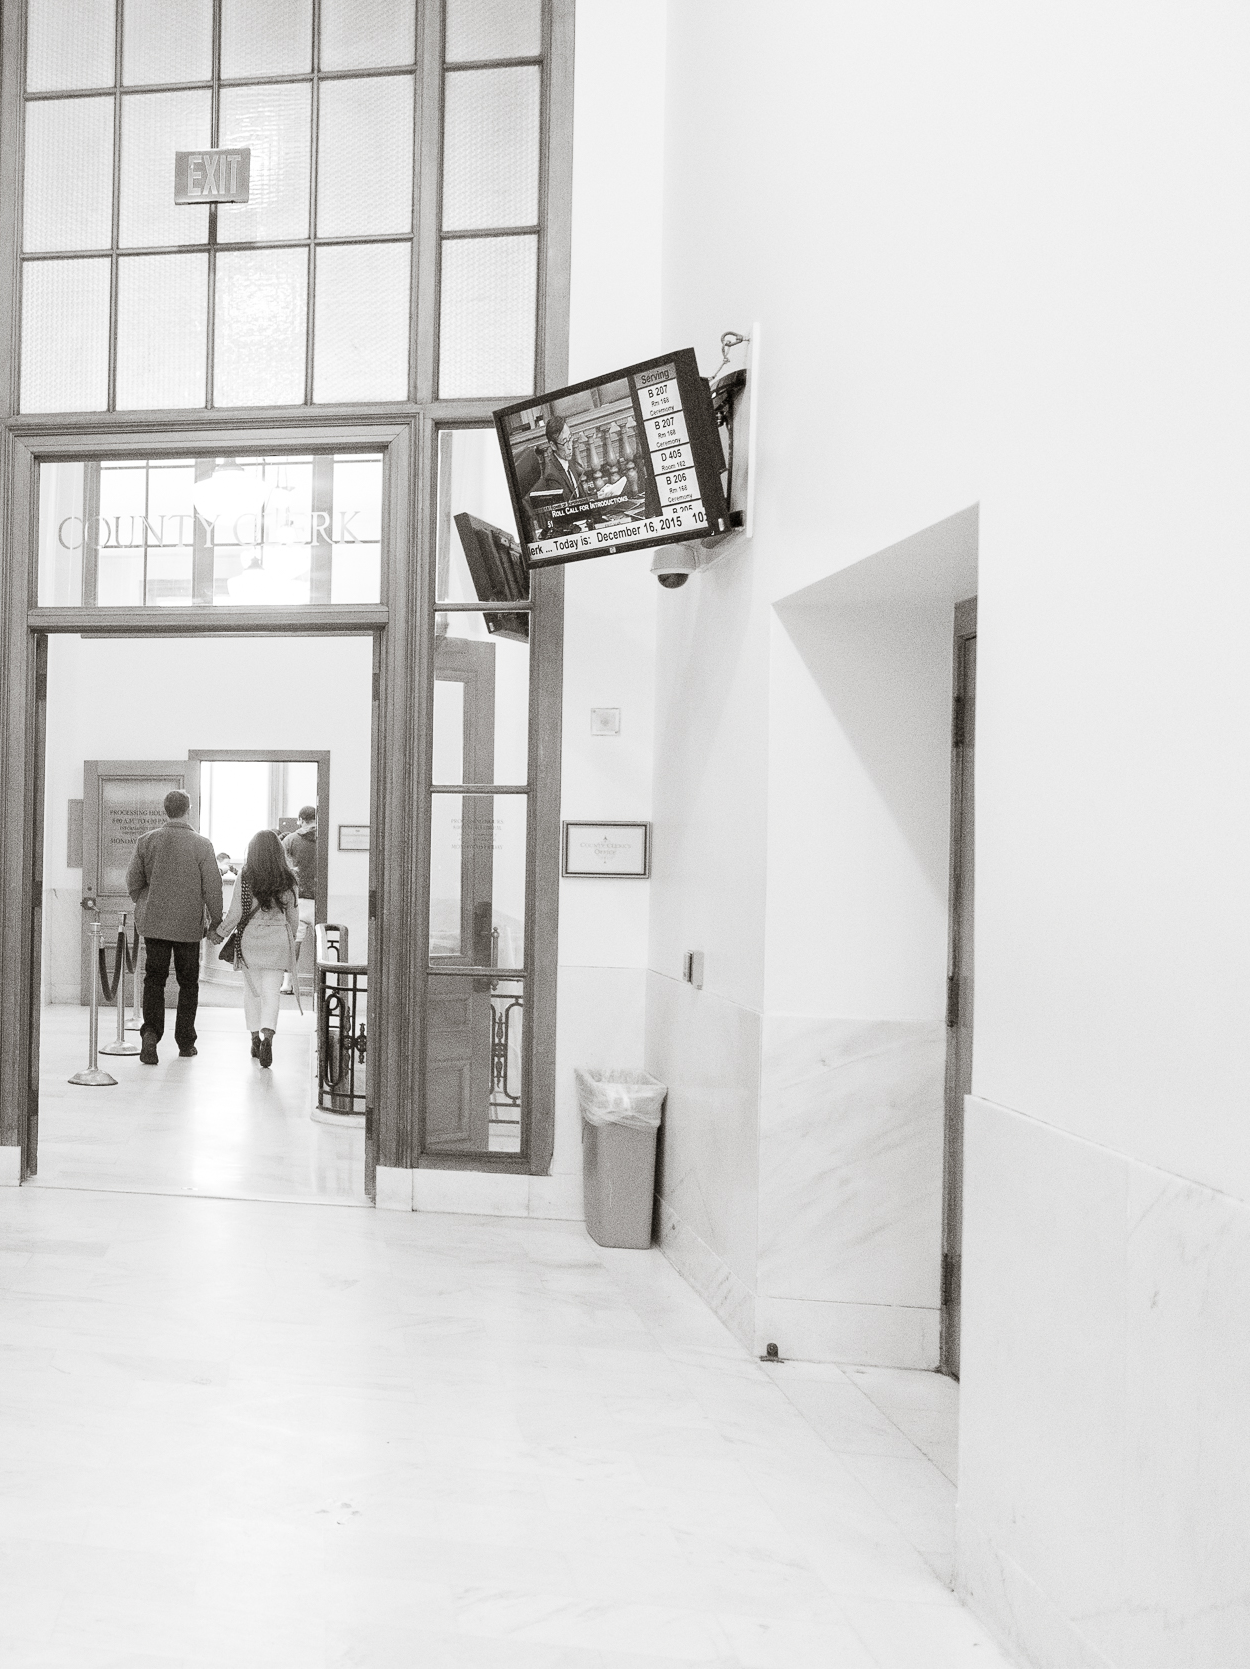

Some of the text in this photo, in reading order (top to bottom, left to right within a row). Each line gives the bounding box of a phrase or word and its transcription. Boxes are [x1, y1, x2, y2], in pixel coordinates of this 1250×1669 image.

[188, 155, 241, 195] EXIT
[641, 370, 670, 384] Serving
[648, 385, 668, 398] B 207
[650, 405, 675, 416] Ceremony
[655, 417, 674, 430] B 207
[656, 438, 681, 448] Ceremony
[661, 449, 682, 462] D 405
[661, 463, 676, 471] Room
[666, 473, 687, 485] B 206
[668, 493, 693, 503] Ceremony
[58, 511, 362, 550] COUNTY CLERK
[553, 538, 579, 555] Today
[580, 535, 592, 546] is:
[596, 525, 641, 543] December
[643, 521, 658, 534] 16,
[659, 516, 683, 530] 2015
